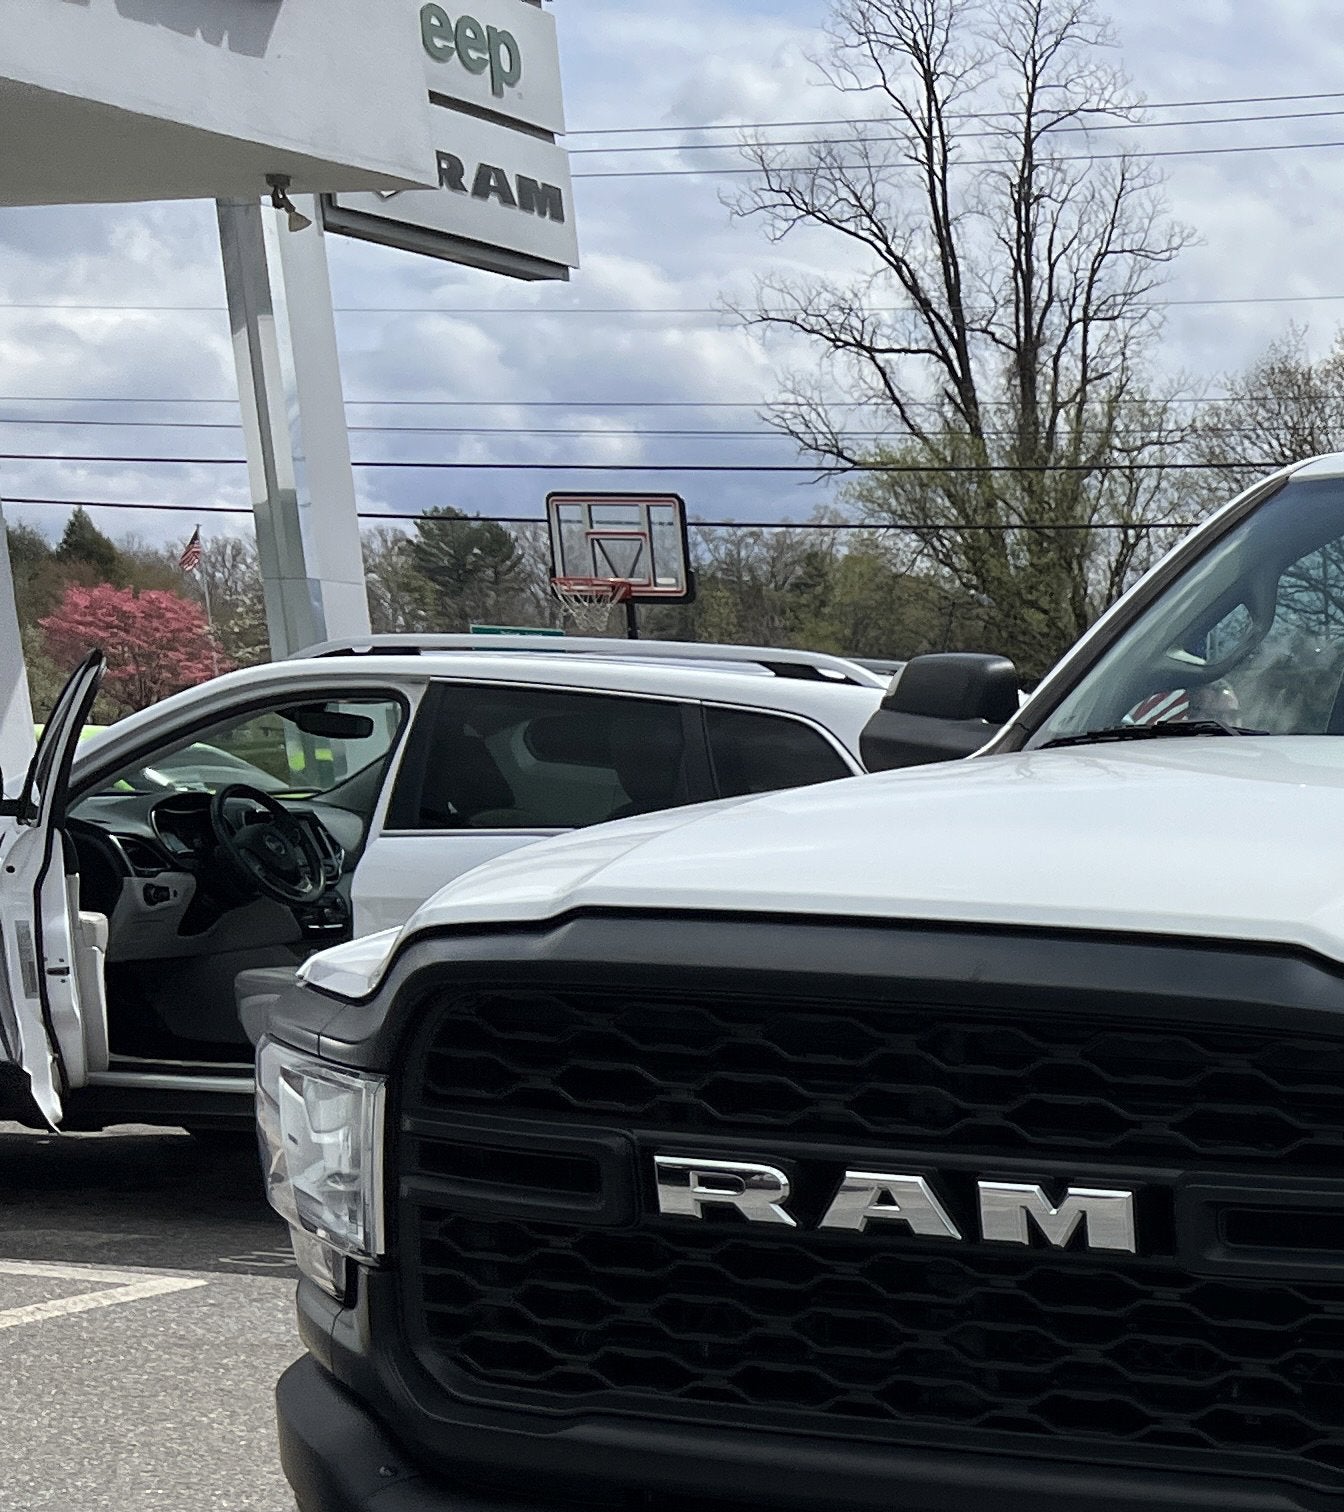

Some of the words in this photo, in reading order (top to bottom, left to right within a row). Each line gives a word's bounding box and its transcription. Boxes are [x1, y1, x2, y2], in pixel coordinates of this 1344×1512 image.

[420, 2, 521, 97] eep
[435, 149, 565, 224] RAM
[653, 1154, 1137, 1254] RAM
